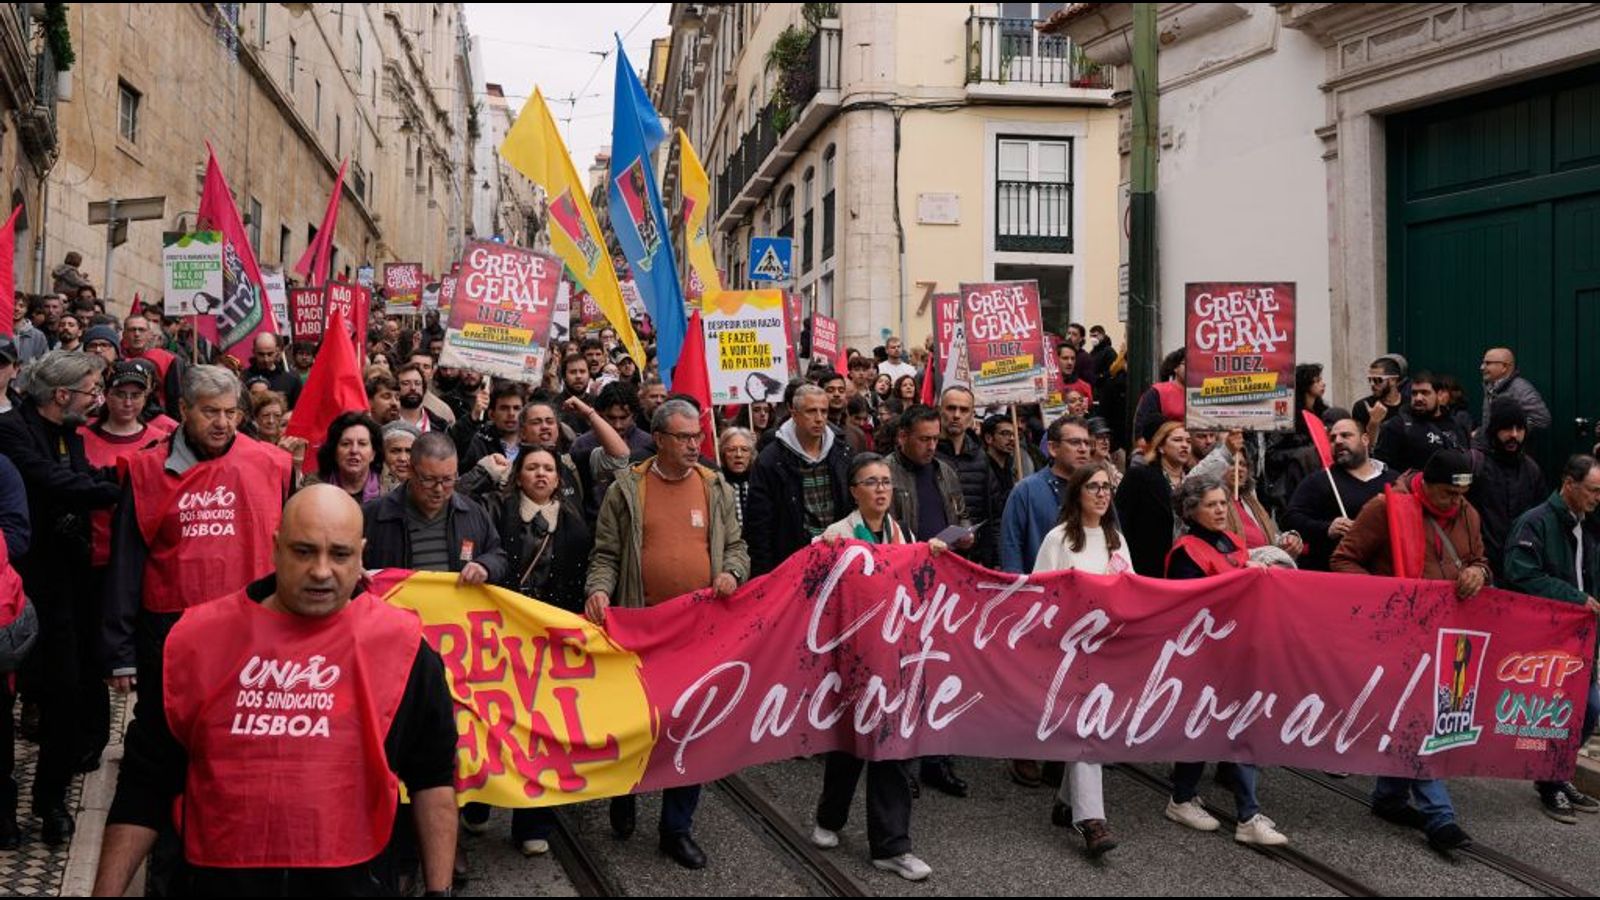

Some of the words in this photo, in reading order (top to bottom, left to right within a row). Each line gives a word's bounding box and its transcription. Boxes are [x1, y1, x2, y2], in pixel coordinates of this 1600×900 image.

[470, 248, 547, 285] GREVE
[297, 291, 317, 306] NÃO
[332, 286, 351, 301] NÃO
[465, 272, 548, 313] GERAL
[916, 282, 937, 316] 7
[968, 286, 1029, 315] GREVE
[299, 307, 322, 320] PACO
[1194, 287, 1279, 323] GREVE
[296, 322, 321, 335] LABO
[708, 320, 741, 330] DESPEDIR
[743, 319, 758, 328] SEM
[758, 317, 781, 327] RAZÃO
[972, 307, 1036, 340] GERAL
[1195, 313, 1287, 353] GERAL
[728, 332, 756, 343] FAZER
[730, 344, 770, 356] VONTADE
[987, 343, 997, 358] 11
[722, 359, 734, 370] AO
[1214, 355, 1228, 372] 11
[1231, 355, 1268, 372] DEZ.
[1211, 384, 1238, 393] PACOTE
[1239, 382, 1271, 392] LABORAL
[1223, 377, 1252, 385] CONTRA
[178, 486, 236, 509] UNIÃO
[806, 545, 1124, 654] Contra
[1176, 607, 1237, 657] a
[239, 654, 341, 691] UNIÃO
[423, 611, 596, 714] REVE
[1497, 651, 1584, 688] CGTP
[236, 690, 264, 708] DOS
[265, 691, 335, 710] SINDICATOS
[667, 635, 984, 774] Pacote
[1036, 639, 1431, 754] laboral!
[1495, 688, 1573, 728] UNIÃO
[231, 713, 330, 737] LISBOA
[1436, 711, 1470, 735] CGTP
[453, 686, 620, 798] ERAL
